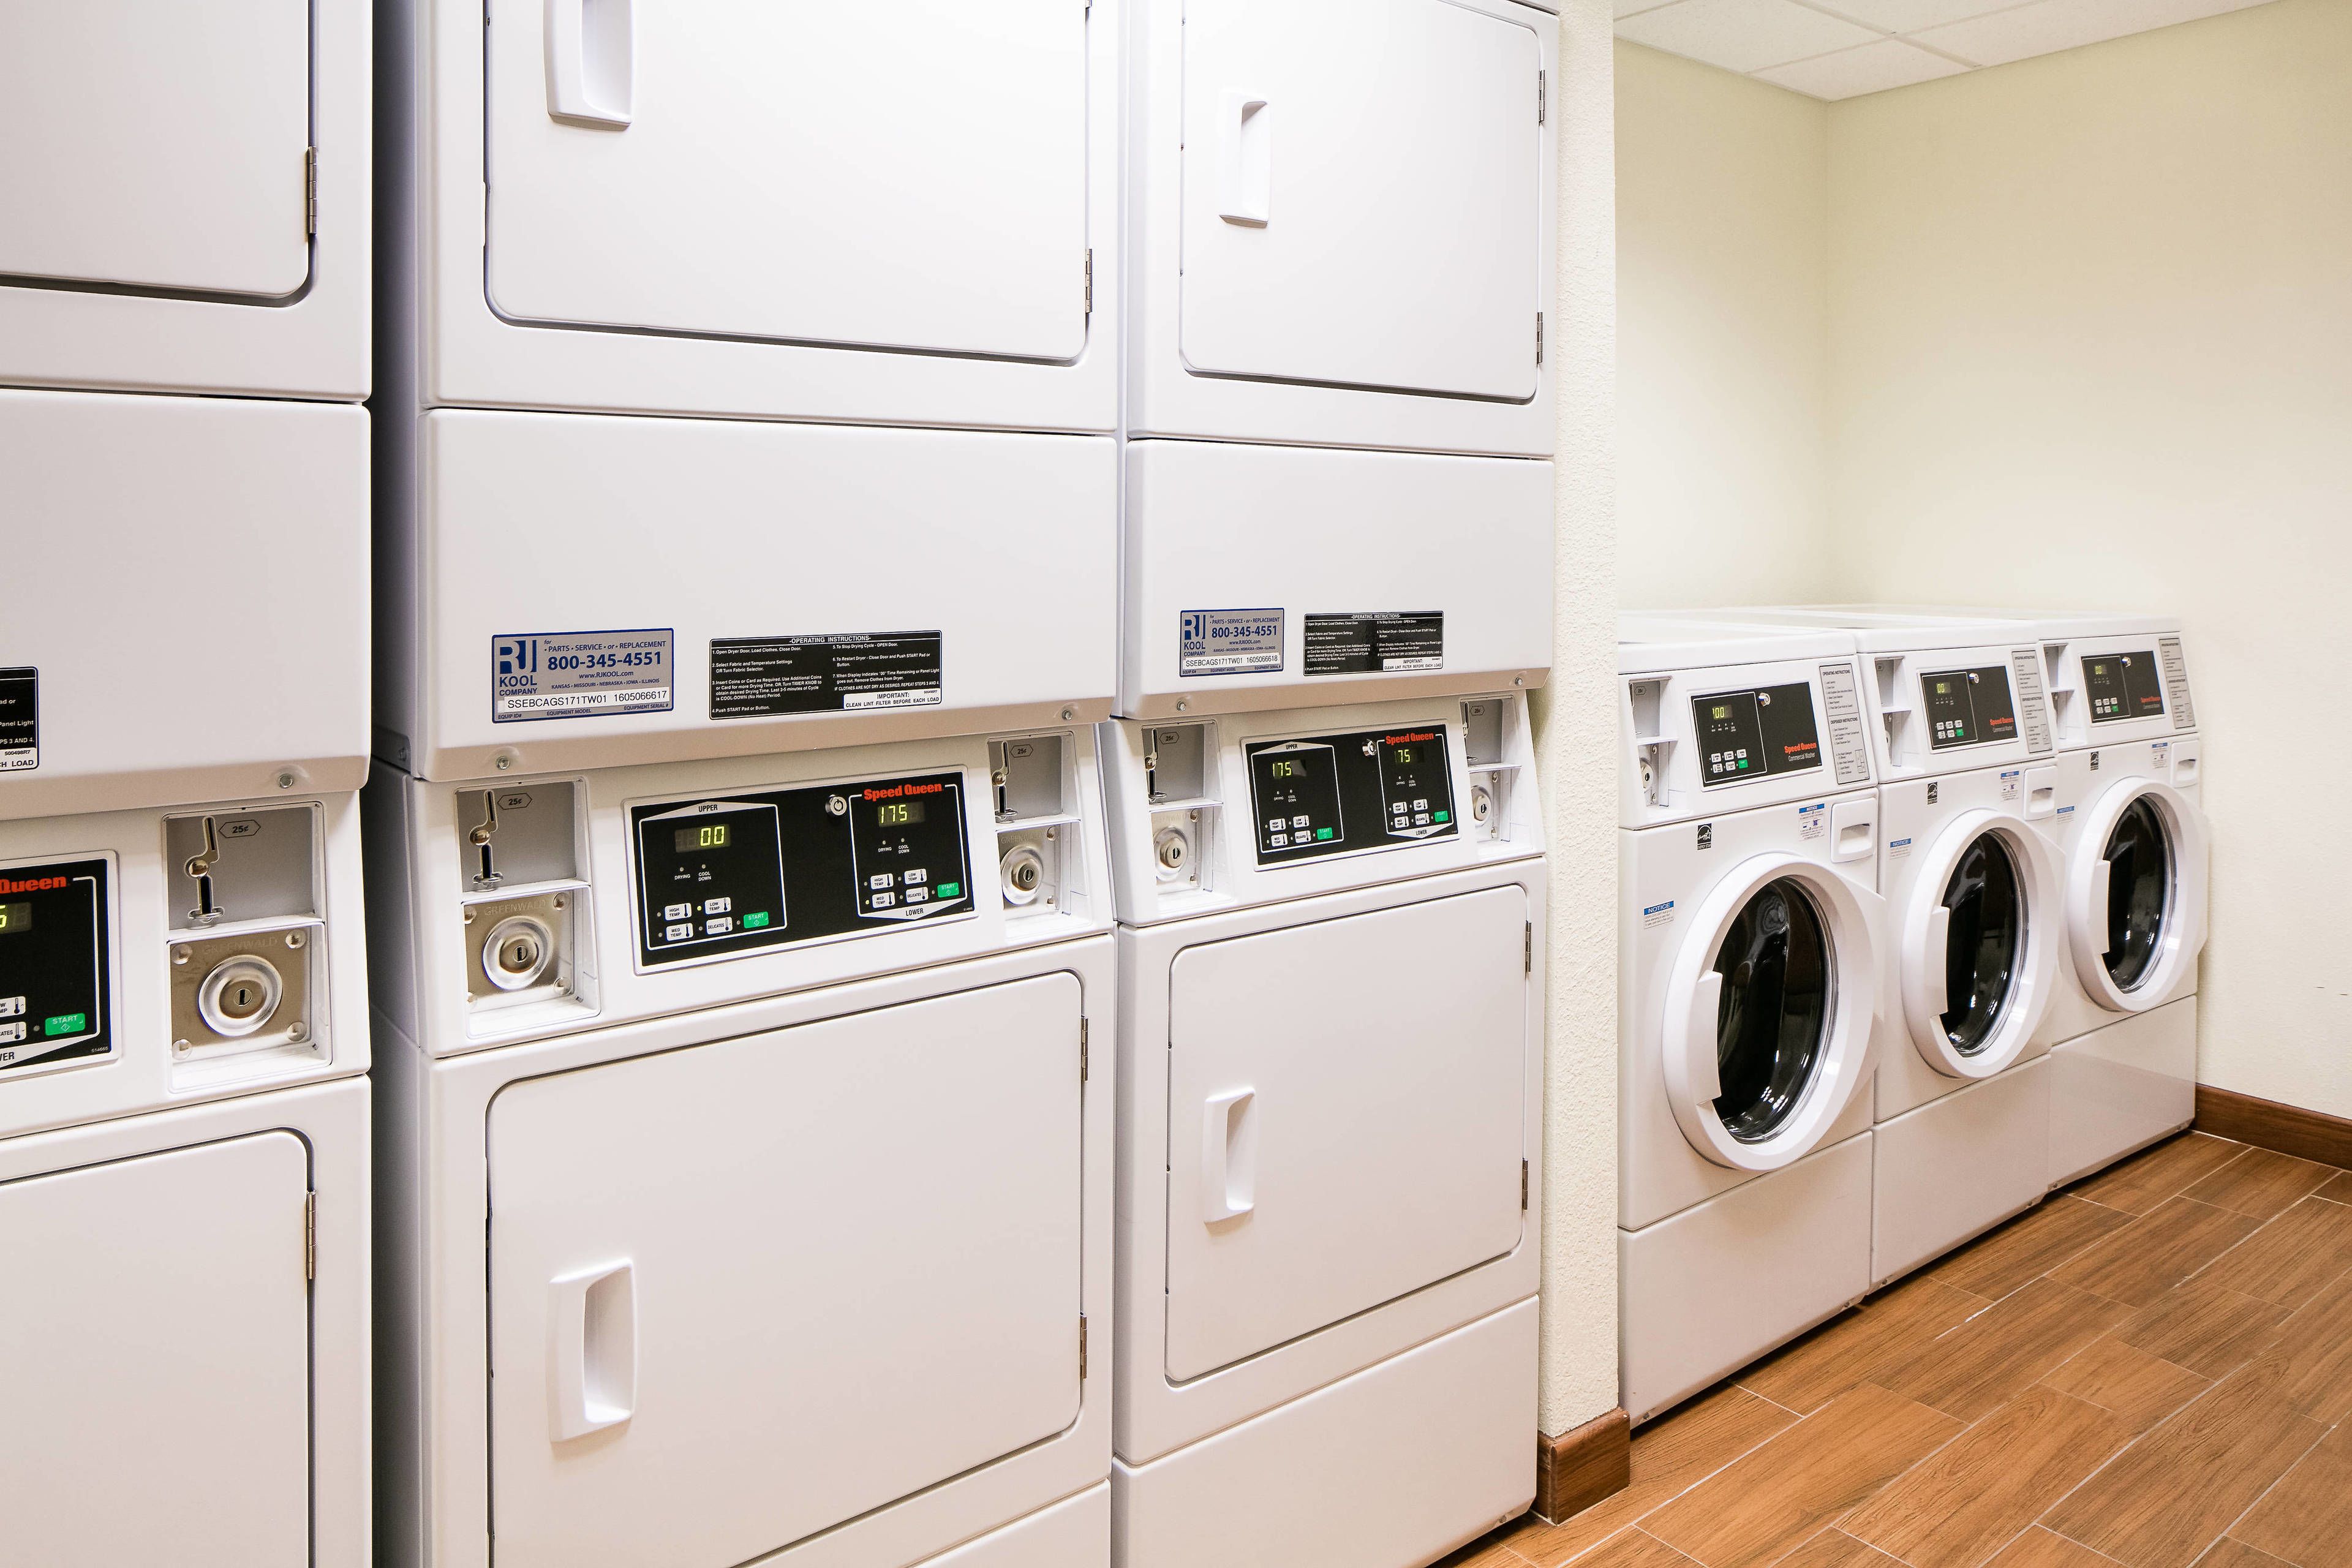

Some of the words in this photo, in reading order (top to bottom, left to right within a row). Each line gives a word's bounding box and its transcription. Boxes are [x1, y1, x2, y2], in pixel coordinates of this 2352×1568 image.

[1212, 625, 1277, 638] 800-345-4551
[1184, 641, 1206, 650] KOOL
[548, 651, 661, 670] 800-345-4551
[1185, 657, 1243, 667] SSEBCAGS171TW01
[1246, 655, 1278, 663] 1605066618
[499, 675, 537, 687] KOOL
[499, 688, 538, 696] COMPANY
[508, 695, 607, 709] SSEBCAGS171TW01
[614, 690, 667, 702] 1605066617
[1385, 734, 1409, 745] Speed
[1411, 732, 1434, 742] Queen
[1784, 744, 1801, 754] Speed
[1272, 761, 1292, 778] 175
[864, 787, 902, 801] Speed
[904, 783, 943, 795] Queen
[508, 798, 522, 807] 25¢
[698, 804, 718, 813] UPPER
[880, 804, 908, 824] 175
[232, 824, 249, 834] 25¢
[700, 826, 725, 846] 00
[0, 876, 67, 894] Queen
[484, 899, 546, 917] GREENWALD
[905, 908, 924, 916] LOWER
[1648, 903, 1670, 913] NOTICE
[52, 1016, 78, 1024] START
